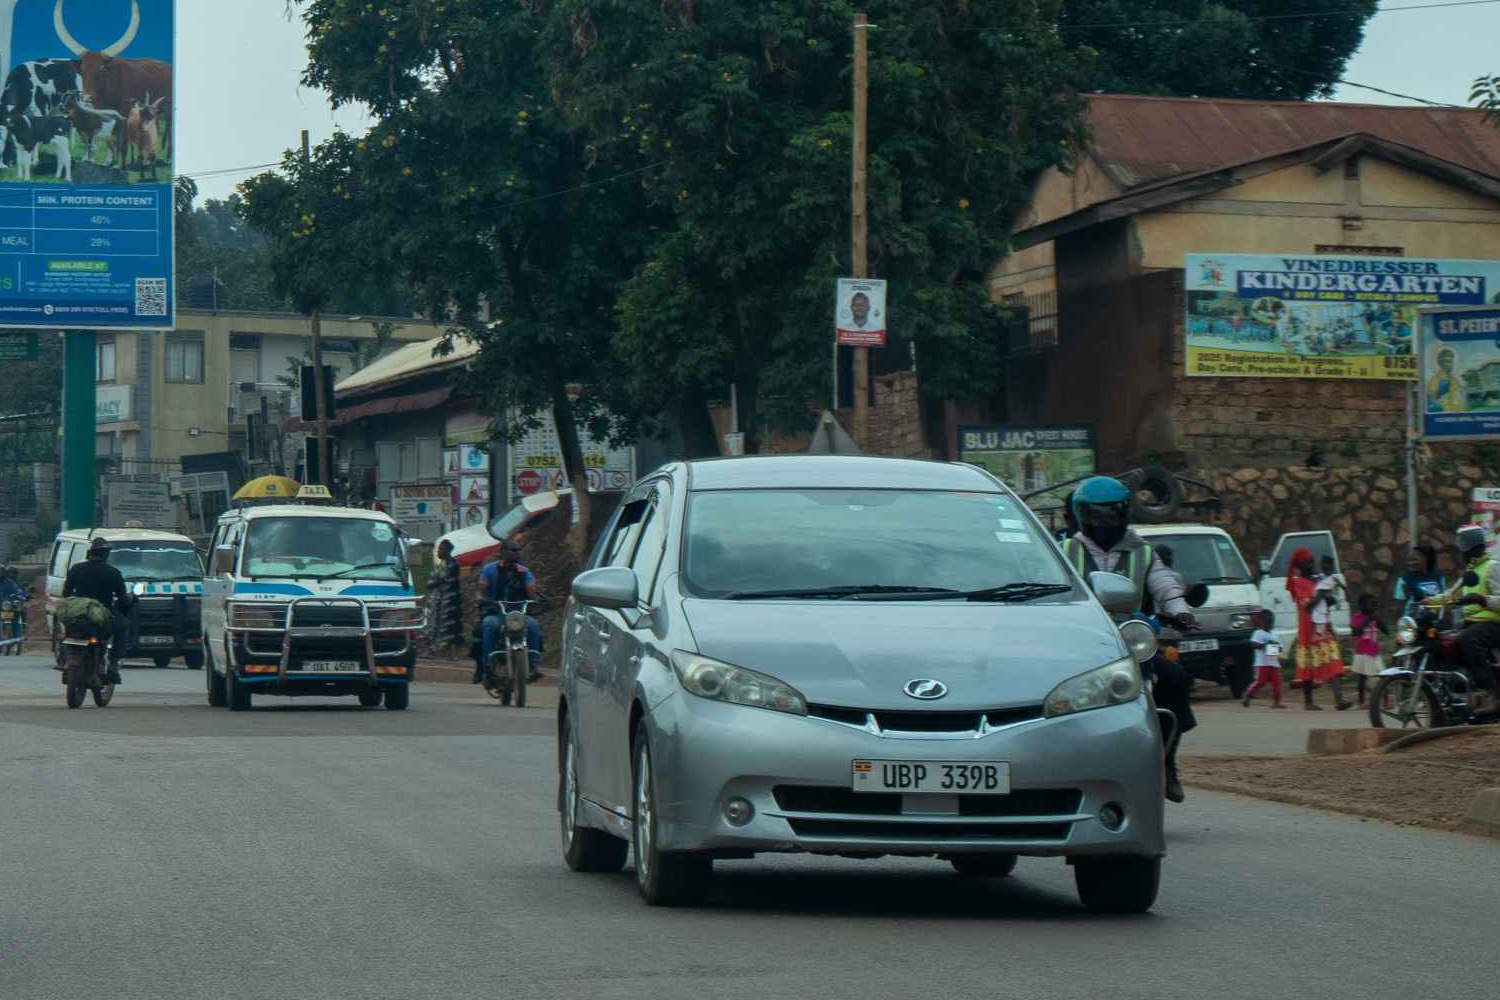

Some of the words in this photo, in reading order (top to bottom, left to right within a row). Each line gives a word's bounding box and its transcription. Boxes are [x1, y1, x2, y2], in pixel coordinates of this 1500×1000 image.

[61, 196, 104, 205] PROTEIN
[106, 197, 153, 206] CONTENT
[90, 215, 111, 225] 46%
[2, 236, 30, 246] MEAL
[90, 238, 111, 247] 28%
[51, 262, 93, 270] AVAILABLE
[94, 262, 105, 270] AT
[1282, 258, 1440, 275] VINEDRESSER
[1242, 271, 1482, 294] KINDERGARTEN
[1319, 292, 1345, 300] CARE
[1197, 353, 1222, 362] 2025
[1225, 353, 1287, 365] Registration
[1288, 355, 1298, 364] in
[1384, 356, 1418, 369] 0756
[1197, 363, 1216, 374] Day
[1248, 365, 1301, 374] Pre-school
[1304, 366, 1312, 375] &
[1315, 366, 1345, 376] Grade
[965, 432, 998, 449] BLU
[1002, 431, 1035, 449] JAC
[527, 456, 557, 466] 0752
[518, 477, 541, 488] STOP
[303, 486, 325, 495] TAXI
[313, 662, 330, 671] UAT
[882, 764, 927, 789] UBP
[941, 764, 999, 790] 339B
